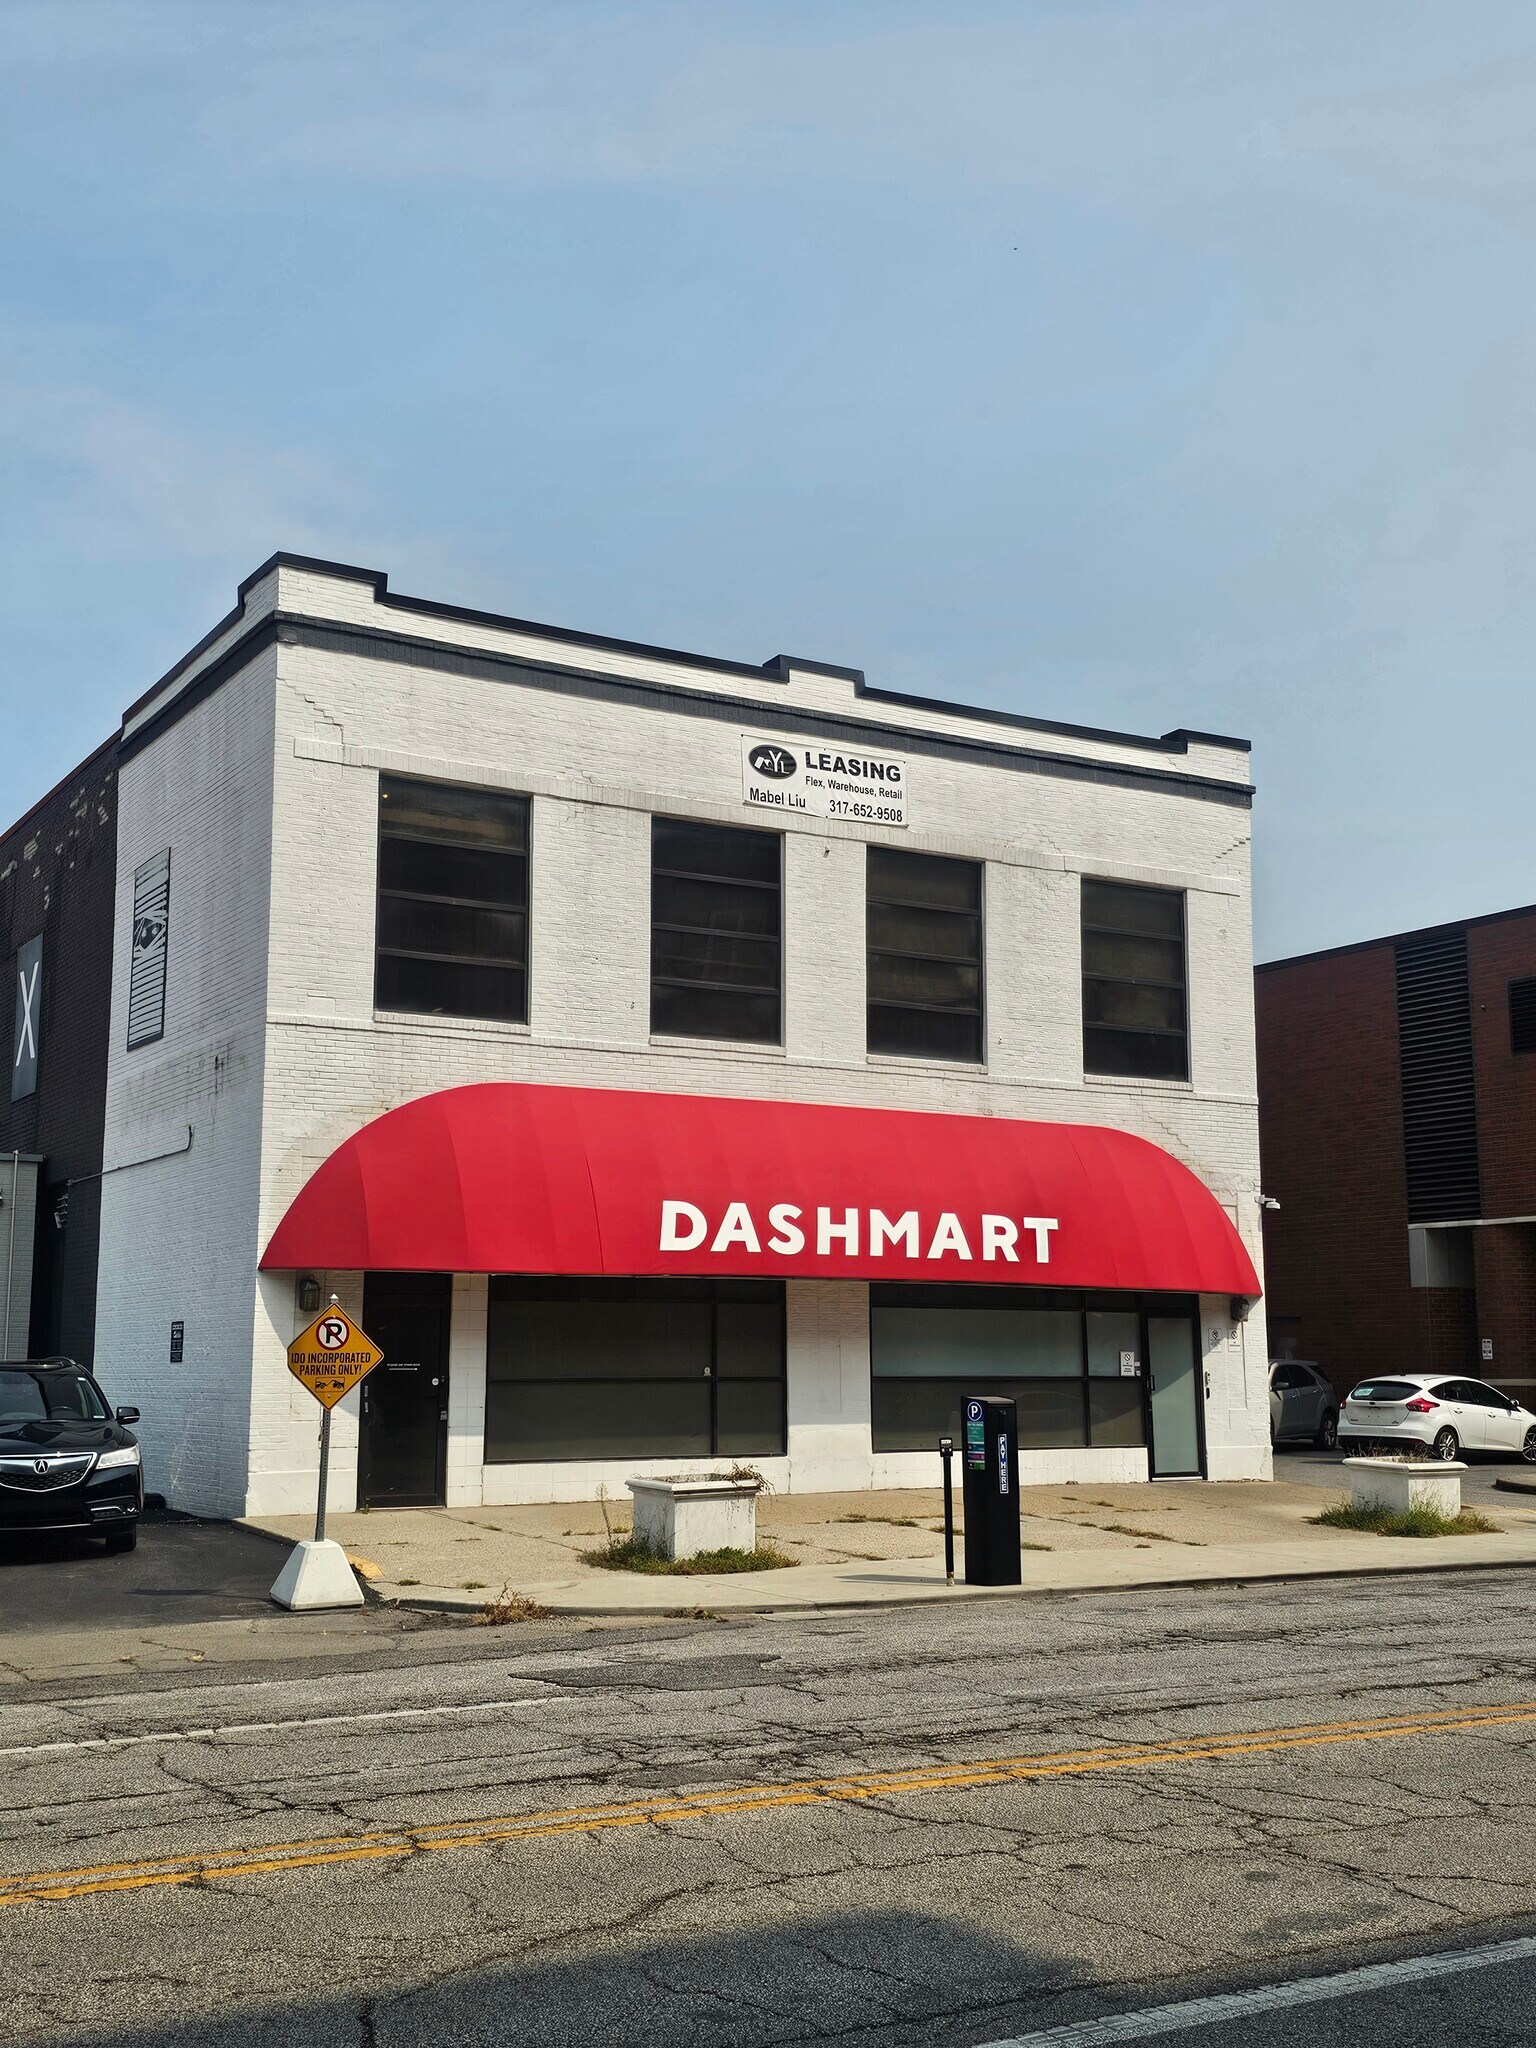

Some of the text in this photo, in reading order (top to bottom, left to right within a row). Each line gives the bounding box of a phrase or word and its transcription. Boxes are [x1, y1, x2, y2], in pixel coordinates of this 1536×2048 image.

[805, 752, 901, 782] LEASING
[750, 788, 806, 808] Mabel Liu
[805, 776, 902, 799] Flex, Warehouse, Retail
[829, 800, 903, 822] 317-652-9508
[659, 1199, 1059, 1264] DASHMART
[308, 1352, 371, 1364] INCORPORATED
[300, 1364, 362, 1375] PARKING ONLY!
